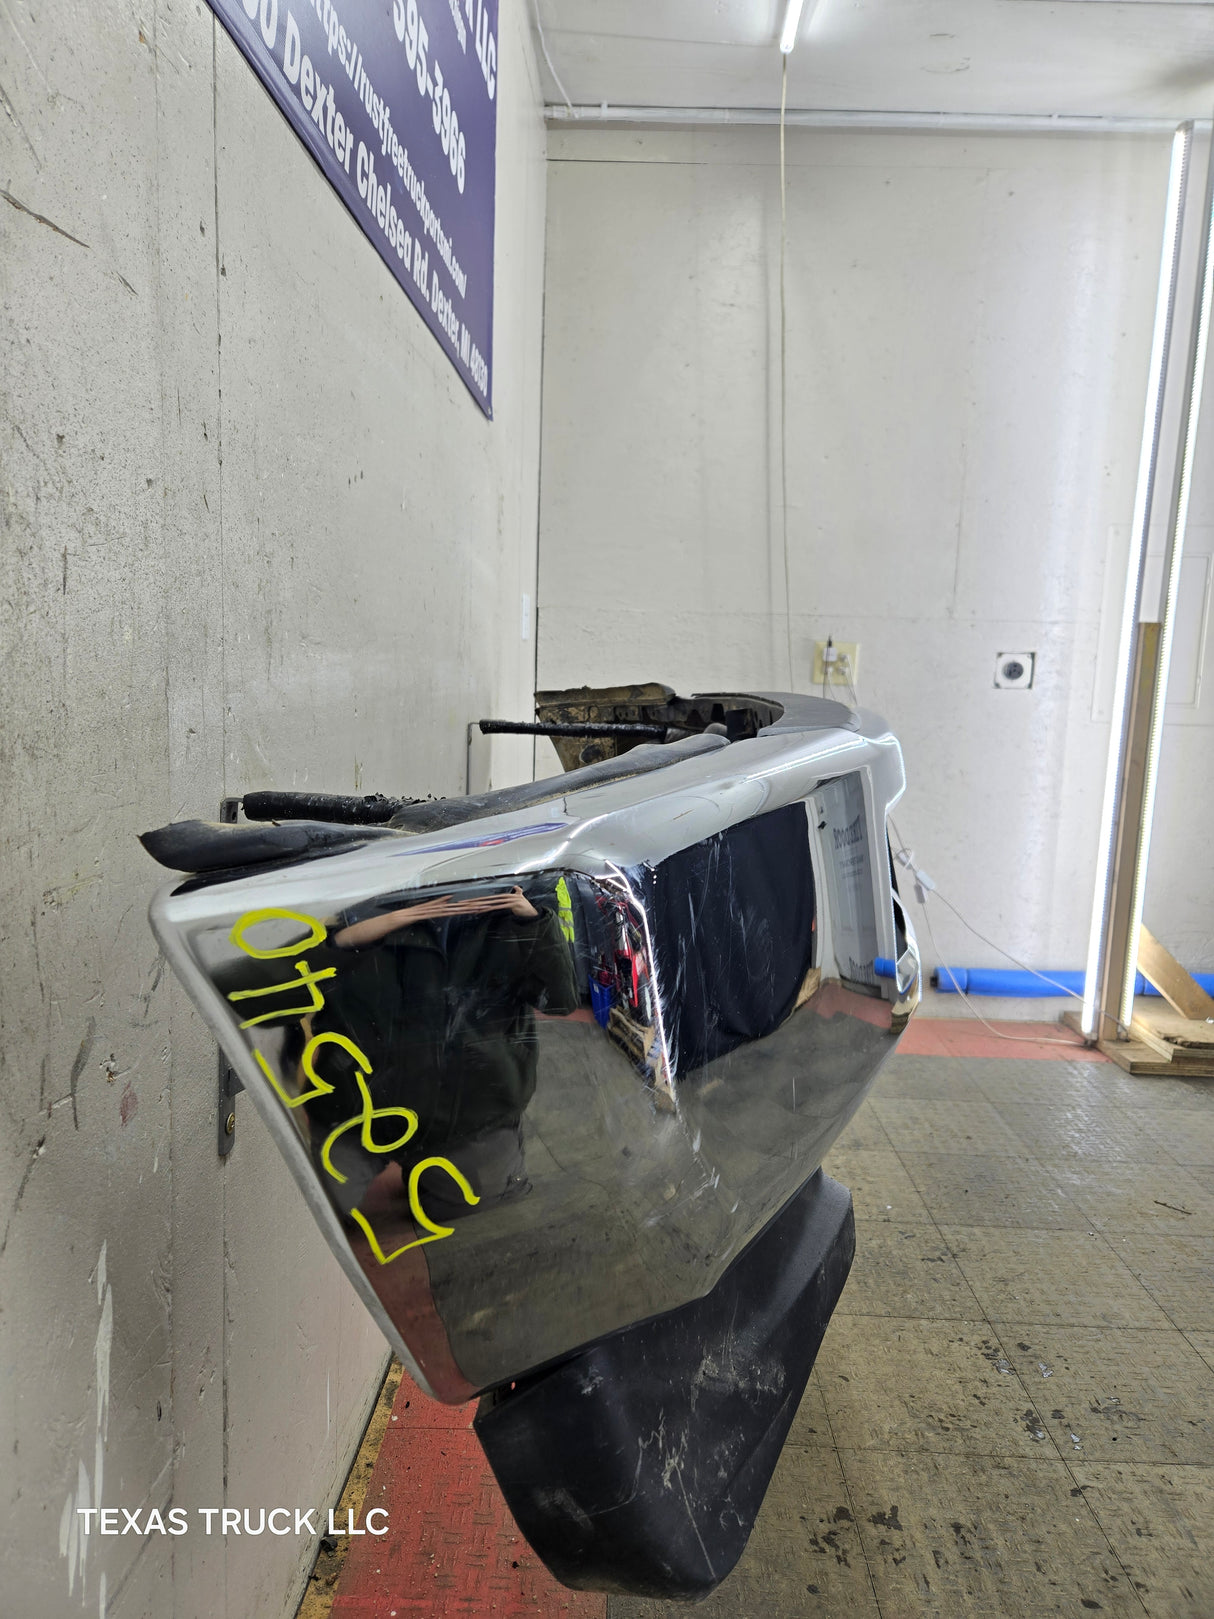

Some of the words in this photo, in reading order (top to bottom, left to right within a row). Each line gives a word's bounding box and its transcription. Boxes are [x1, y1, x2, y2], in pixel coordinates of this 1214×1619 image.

[242, 0, 278, 50] 0
[282, 9, 354, 174] Dexter
[356, 141, 412, 272] Chelsea
[413, 237, 430, 302] Rd.
[431, 269, 460, 359] Dexter,
[229, 907, 481, 1265] 52540
